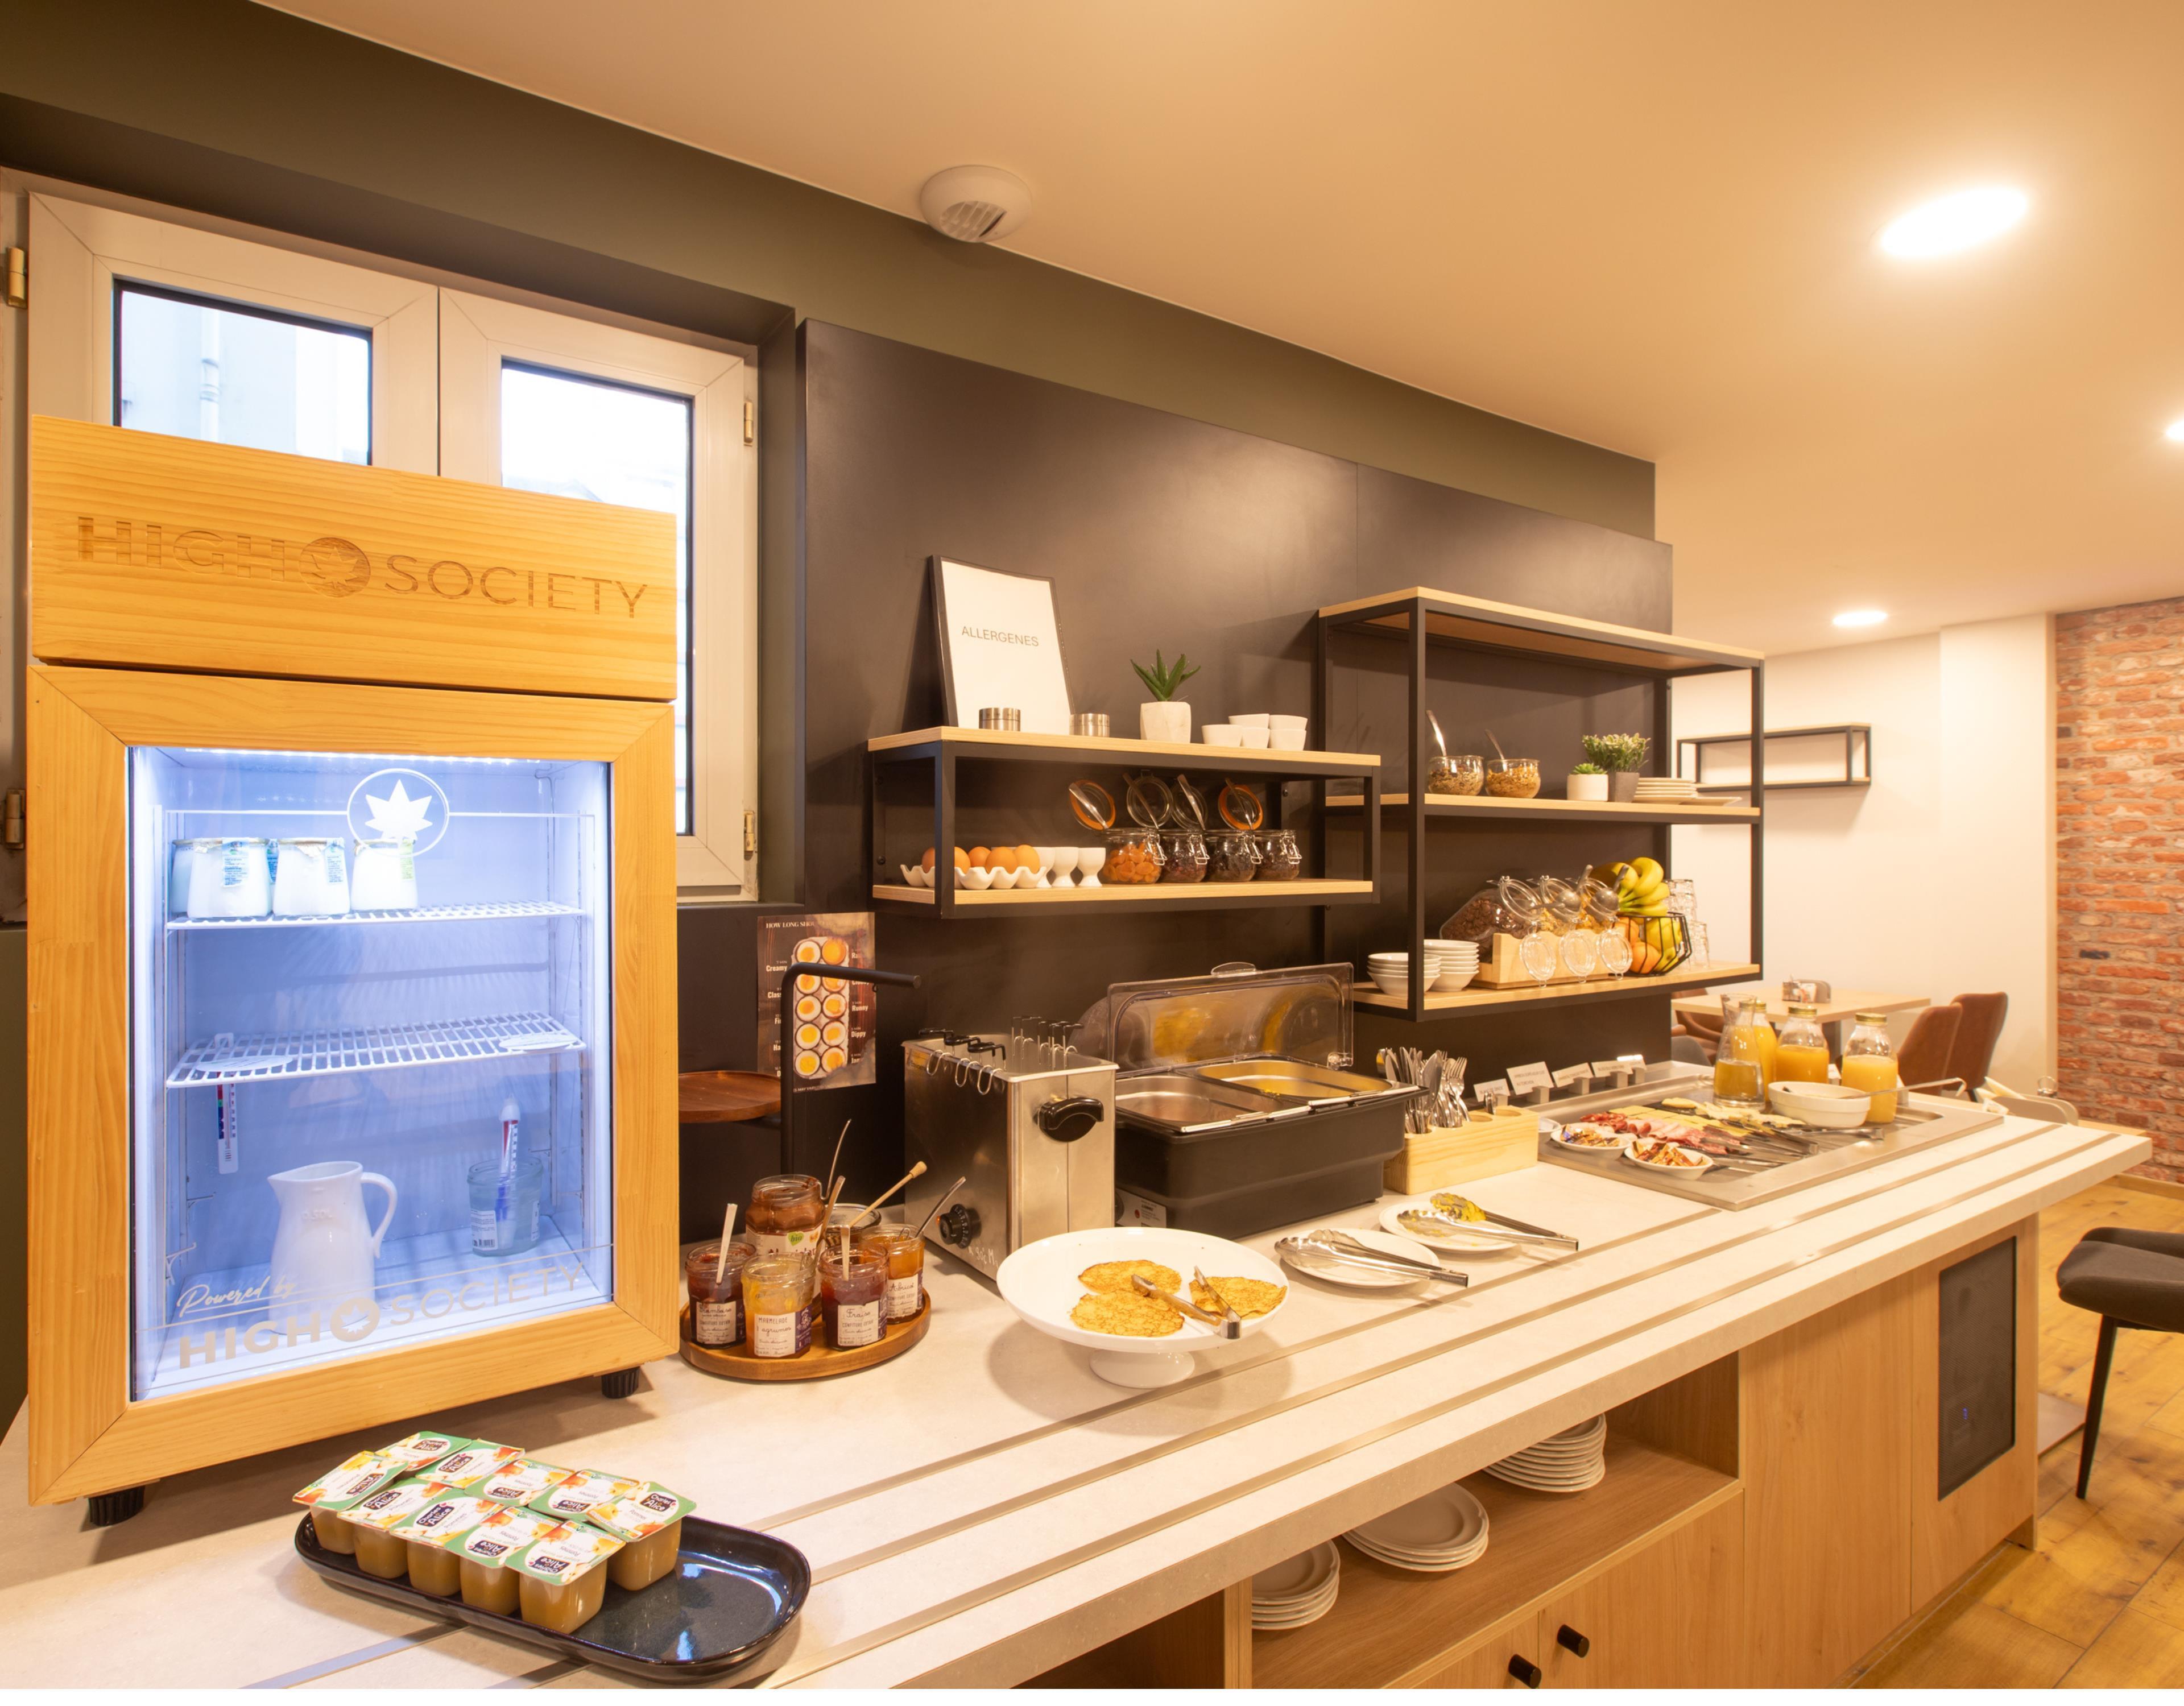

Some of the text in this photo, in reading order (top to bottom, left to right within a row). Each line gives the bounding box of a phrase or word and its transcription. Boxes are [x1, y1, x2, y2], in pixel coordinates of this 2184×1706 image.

[77, 517, 648, 619] HIGH SOCIETY
[961, 626, 1039, 647] ALLERGENES
[851, 1030, 866, 1039] Dippy
[177, 1275, 297, 1318] Powered by
[179, 1262, 585, 1369] HIGH SOCIETY
[758, 1316, 788, 1324] MARMELADE
[846, 1308, 871, 1318] Fraise
[761, 1326, 792, 1337] agrumes
[450, 1457, 471, 1472] Alice
[366, 1492, 389, 1507] Charles
[375, 1492, 399, 1509] Alice
[643, 1500, 665, 1511] Alice
[651, 1494, 672, 1504] Charles
[419, 1506, 441, 1525] Charles
[428, 1507, 453, 1525] Alice
[479, 1541, 504, 1552] Alice
[540, 1558, 565, 1569] Alice
